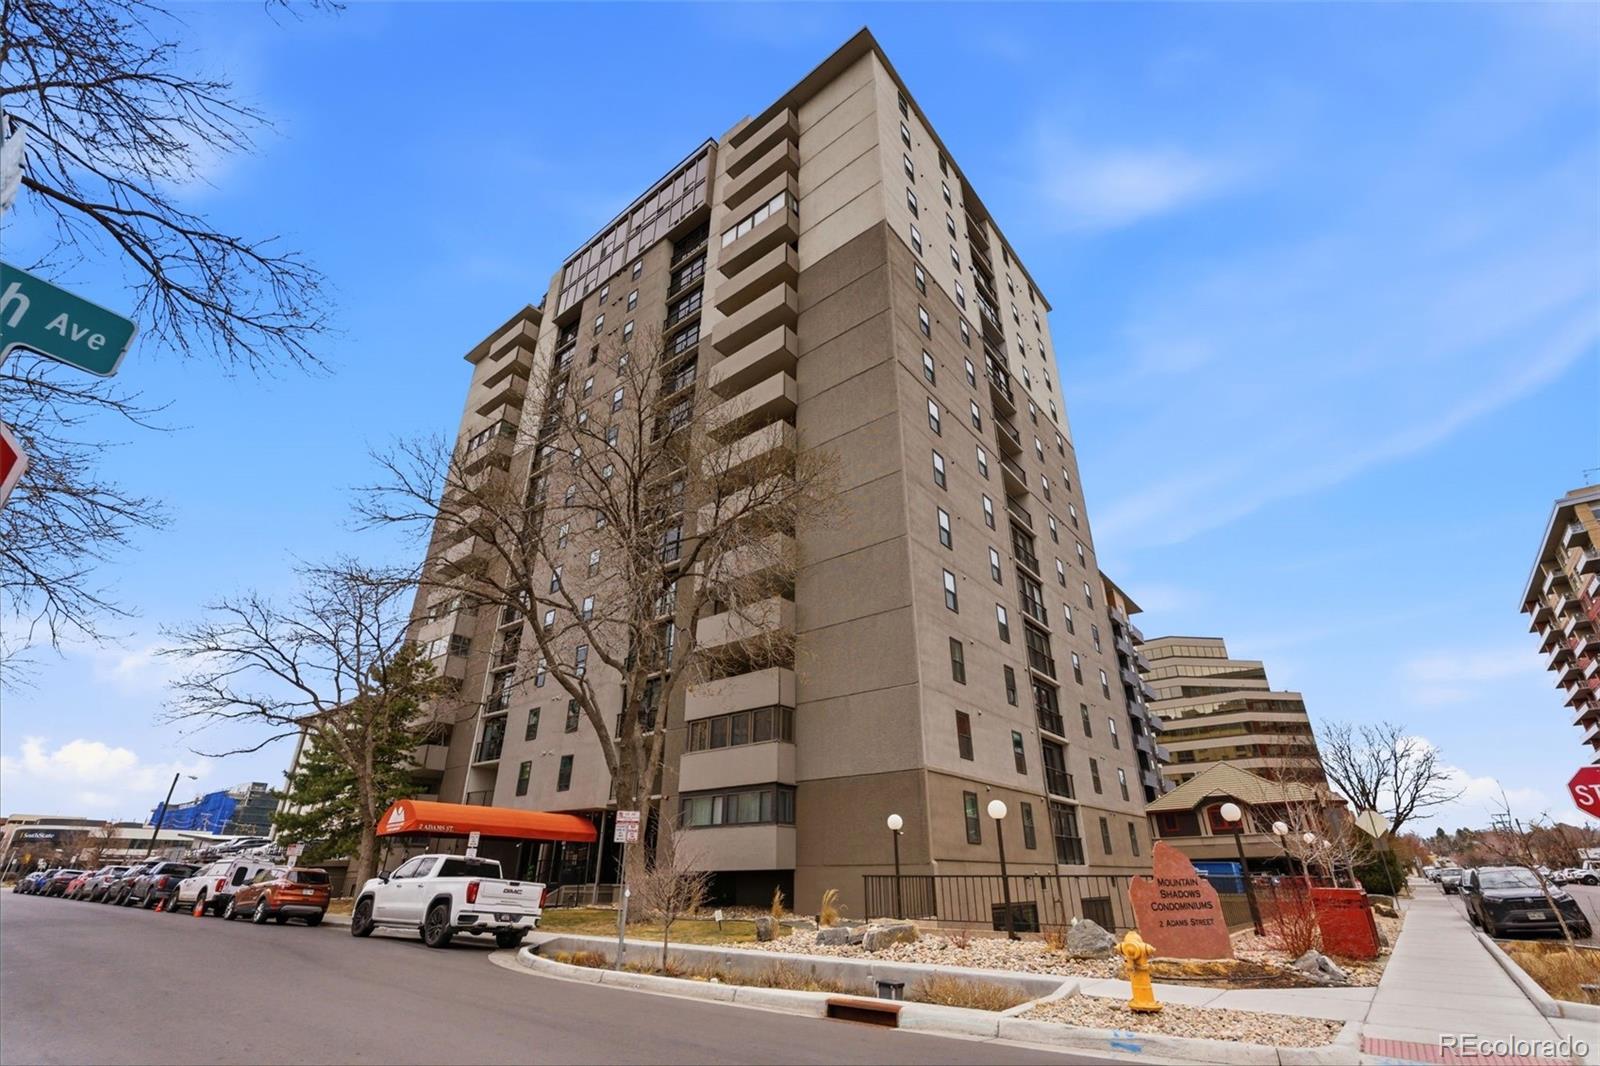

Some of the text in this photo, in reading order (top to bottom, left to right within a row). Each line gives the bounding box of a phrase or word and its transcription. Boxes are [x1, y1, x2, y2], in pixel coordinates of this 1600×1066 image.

[44, 312, 106, 350] Ave
[424, 824, 445, 832] ADAMS
[1157, 879, 1198, 887] MOUNTAIN
[1160, 890, 1201, 898] SHADOWS
[1151, 902, 1213, 911] CONDOMINIUMS
[1159, 918, 1214, 928] 2 ADAMS STREET
